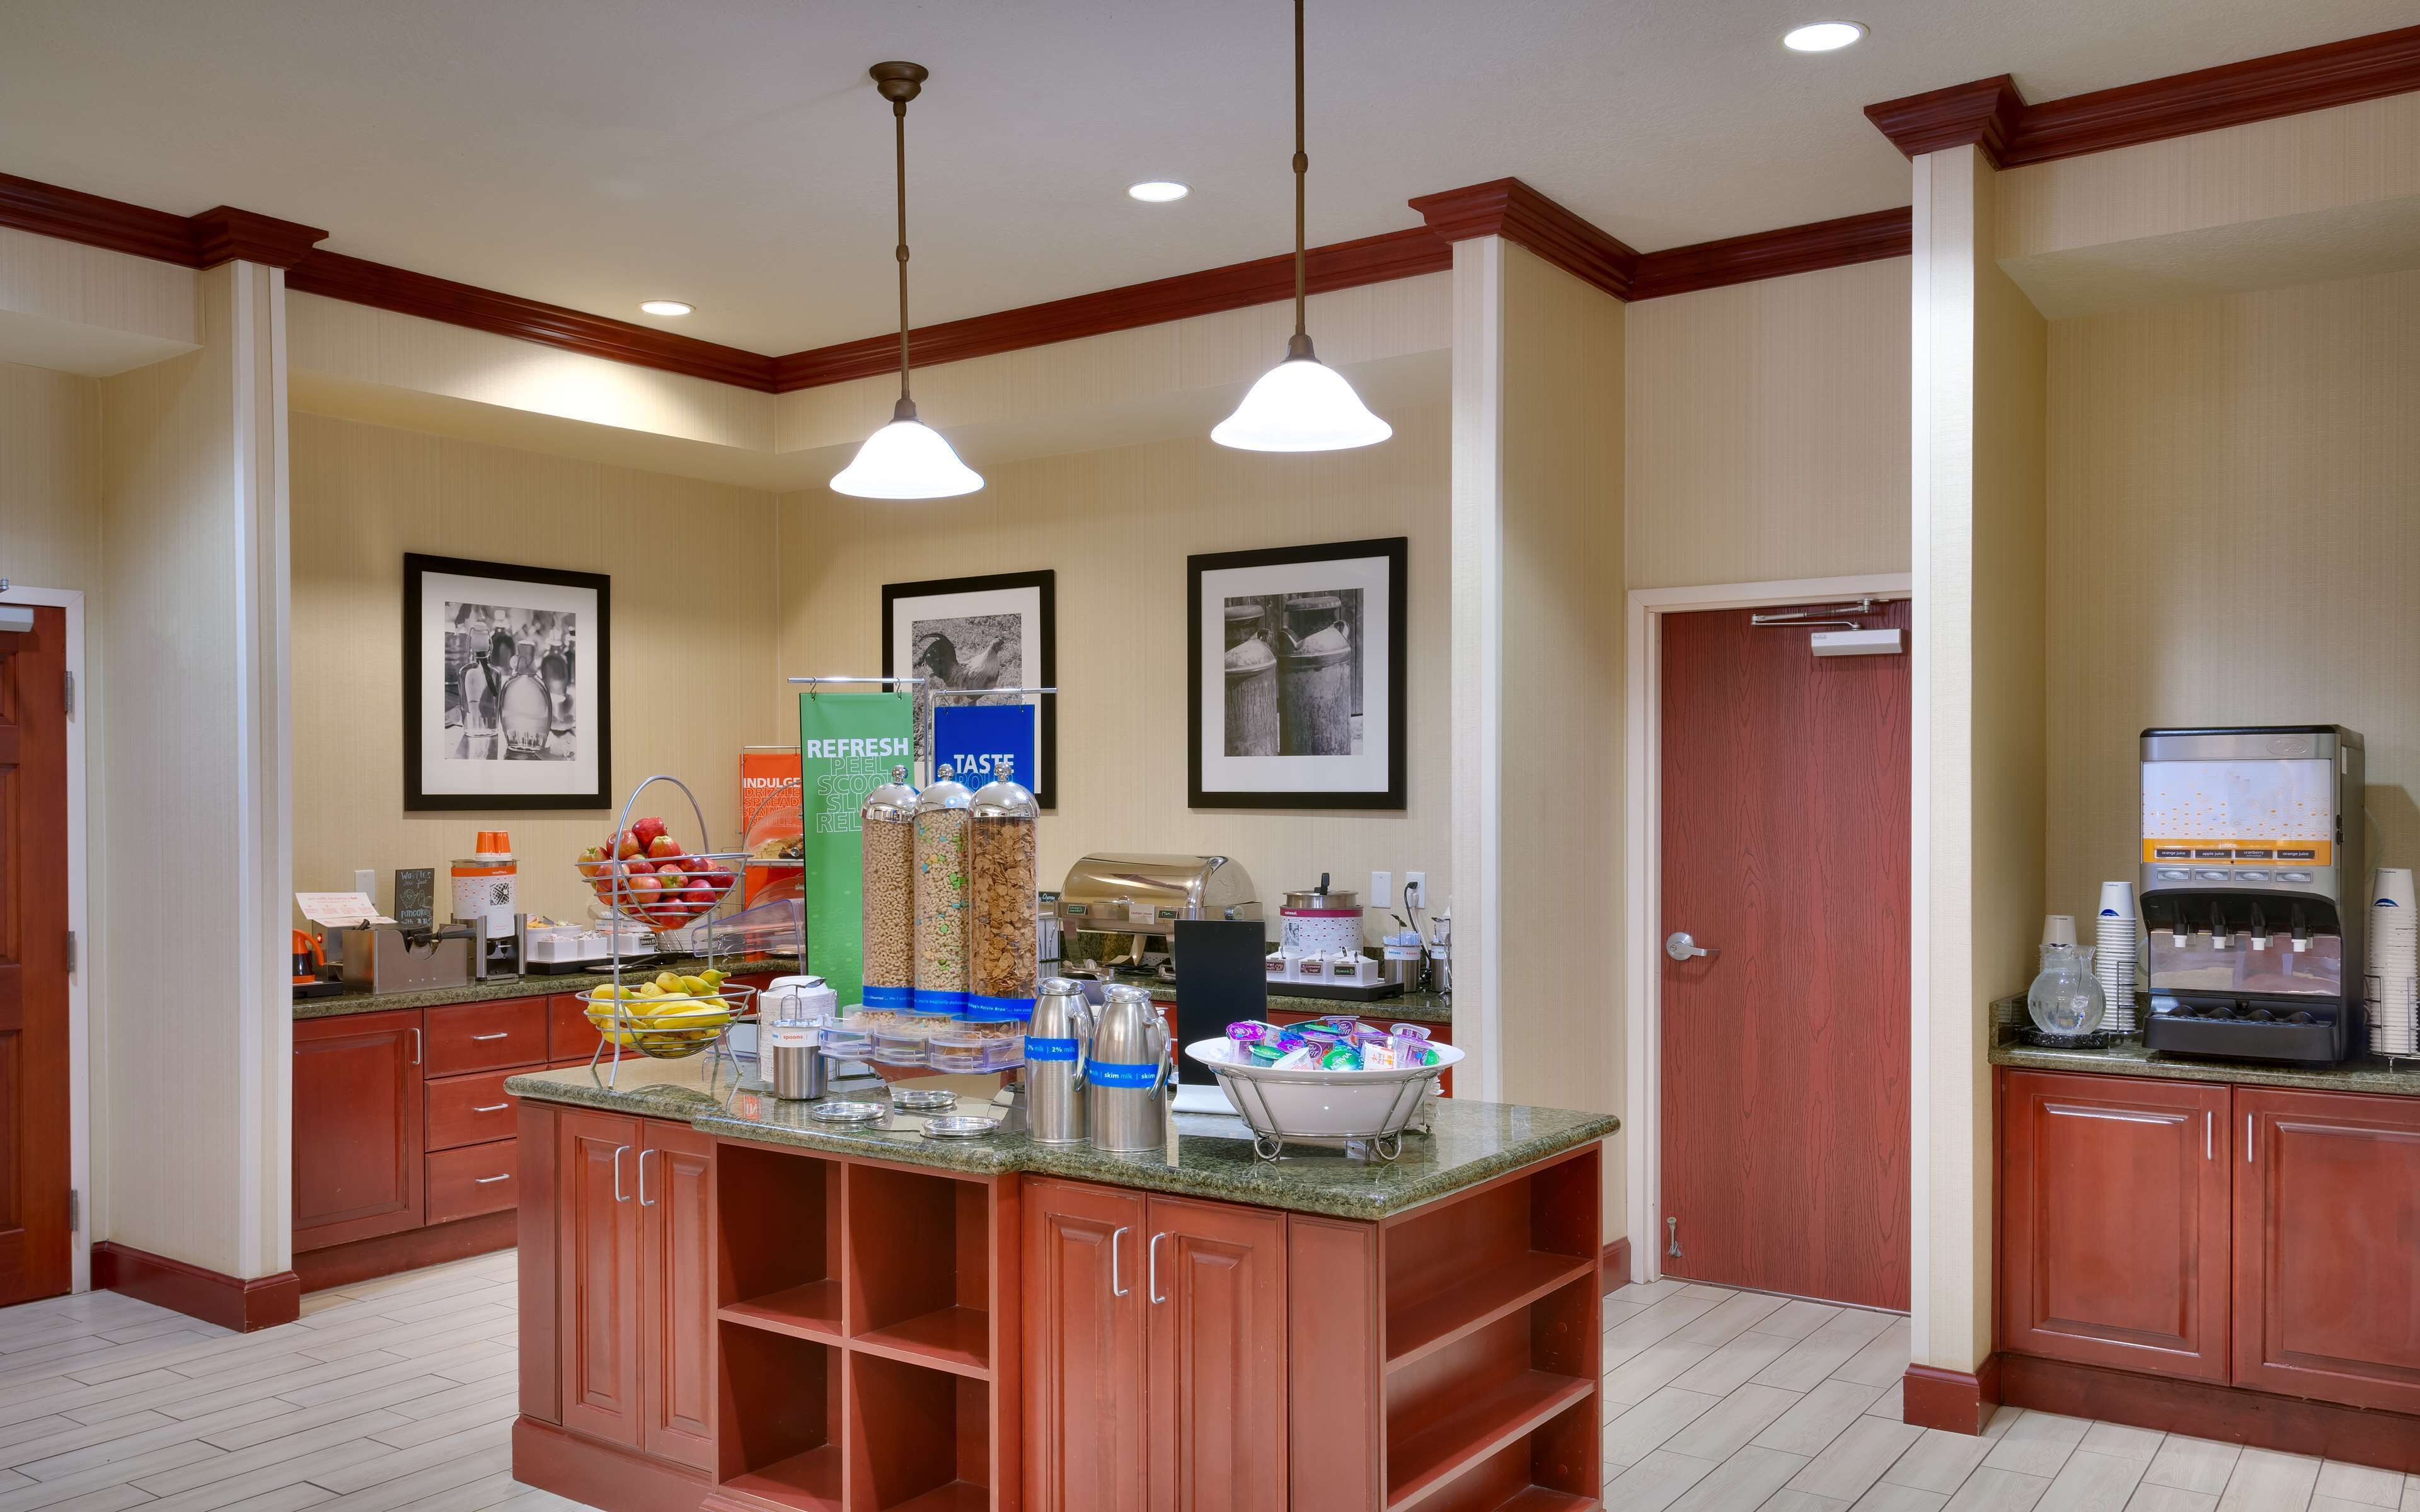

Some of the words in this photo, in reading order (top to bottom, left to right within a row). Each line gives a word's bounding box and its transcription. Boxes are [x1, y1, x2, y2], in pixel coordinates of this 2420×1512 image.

[807, 738, 909, 758] REFRESH
[831, 755, 889, 776] PEEL
[954, 754, 1014, 774] TASTE
[744, 777, 801, 788] INDULGE
[817, 773, 893, 795] SCOO
[955, 772, 1013, 792] PO
[744, 788, 800, 797] DRIZZLE
[744, 796, 800, 807] SPREAD
[739, 806, 798, 818] SPRIN
[827, 793, 863, 814] SLI
[401, 871, 431, 880] Waffles
[401, 908, 431, 919] pancakes
[1330, 1052, 1352, 1070] ACTIVIA
